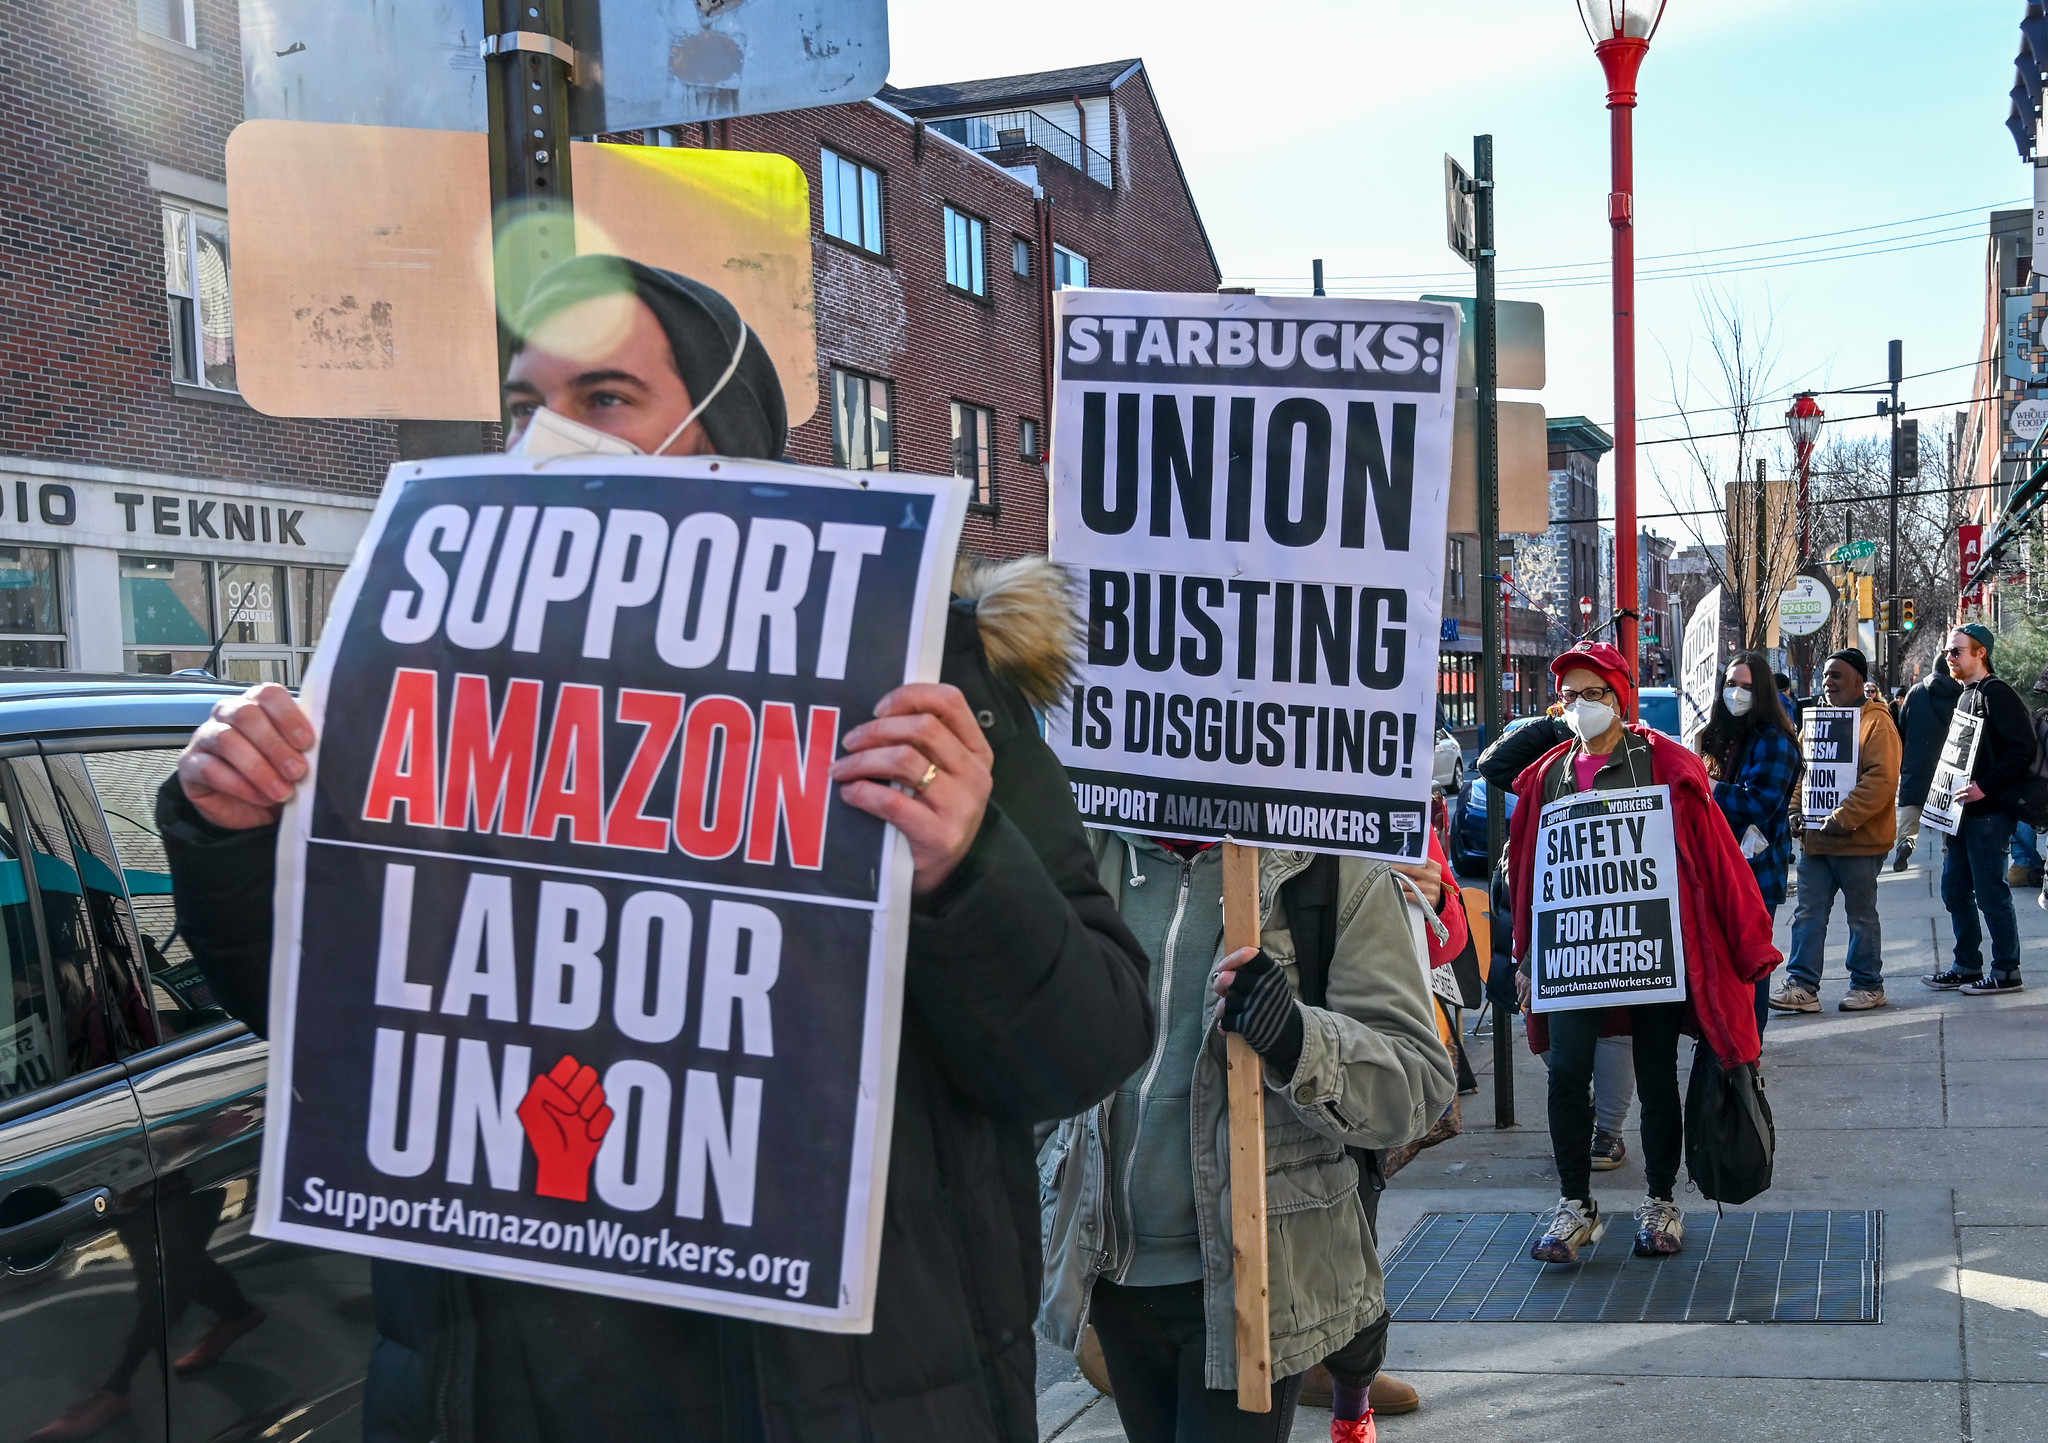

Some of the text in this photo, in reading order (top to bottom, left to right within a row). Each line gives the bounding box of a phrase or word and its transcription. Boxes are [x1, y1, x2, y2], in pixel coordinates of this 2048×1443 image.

[1067, 317, 1440, 375] STARBUCKS:
[2016, 411, 2048, 419] WHOLE
[1080, 391, 1417, 552] UNION
[0, 481, 307, 546] IO TEKNIK
[228, 581, 272, 610] 936
[230, 610, 273, 622] SOUTH
[380, 503, 886, 680] SUPPORT
[1781, 603, 1821, 614] 924308
[1087, 568, 1408, 691] BUSTING
[1071, 684, 1417, 779] IS DISGUSTING!
[361, 667, 840, 870] AMAZON
[1163, 794, 1260, 833] AMAZON
[1265, 802, 1381, 844] WORKERS
[1546, 808, 1571, 826] SUPPORT
[1608, 798, 1653, 813] WORKERS
[1547, 816, 1646, 866] SAFETY
[1542, 857, 1658, 902] & UNIONS
[1556, 905, 1642, 944] FOR ALL
[374, 863, 783, 1058] LABOR
[1544, 939, 1663, 980] WORKERS!
[1540, 975, 1672, 997] SupportAmazonWorkers.org
[366, 1027, 763, 1227] UNON
[303, 1176, 810, 1298] SupportAmazonWorkers.org
